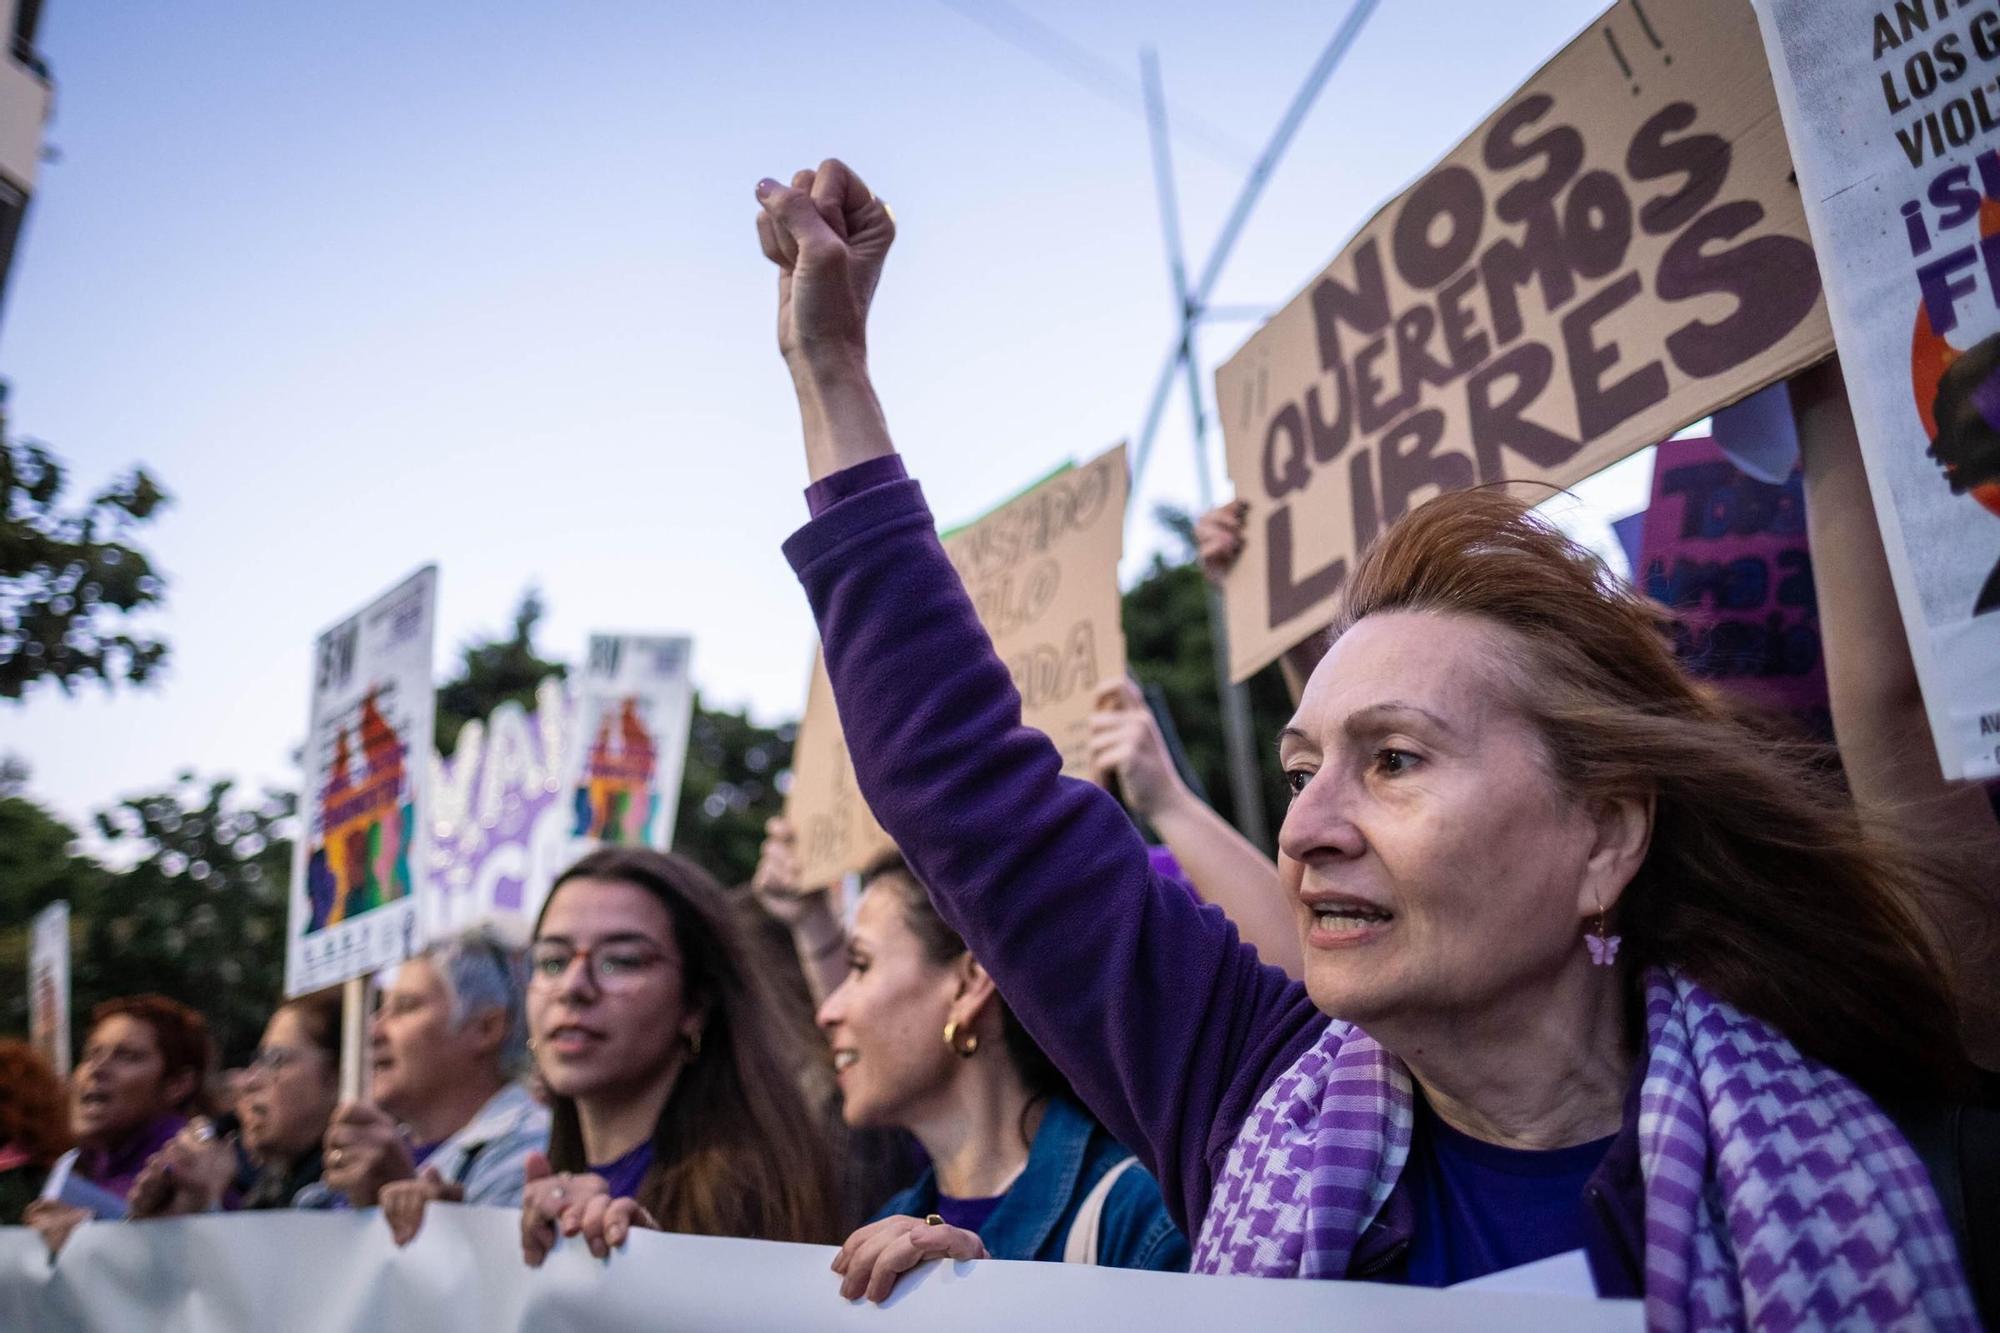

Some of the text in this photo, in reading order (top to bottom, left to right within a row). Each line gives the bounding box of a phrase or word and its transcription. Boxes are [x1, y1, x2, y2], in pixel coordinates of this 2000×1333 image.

[1880, 33, 1968, 116] LOS
[1895, 75, 2000, 169] VIOL
[1261, 101, 1733, 500] QUEREMOS
[1311, 93, 1586, 371] NOS
[1916, 230, 2000, 337] F
[1265, 199, 1823, 631] LIBRES
